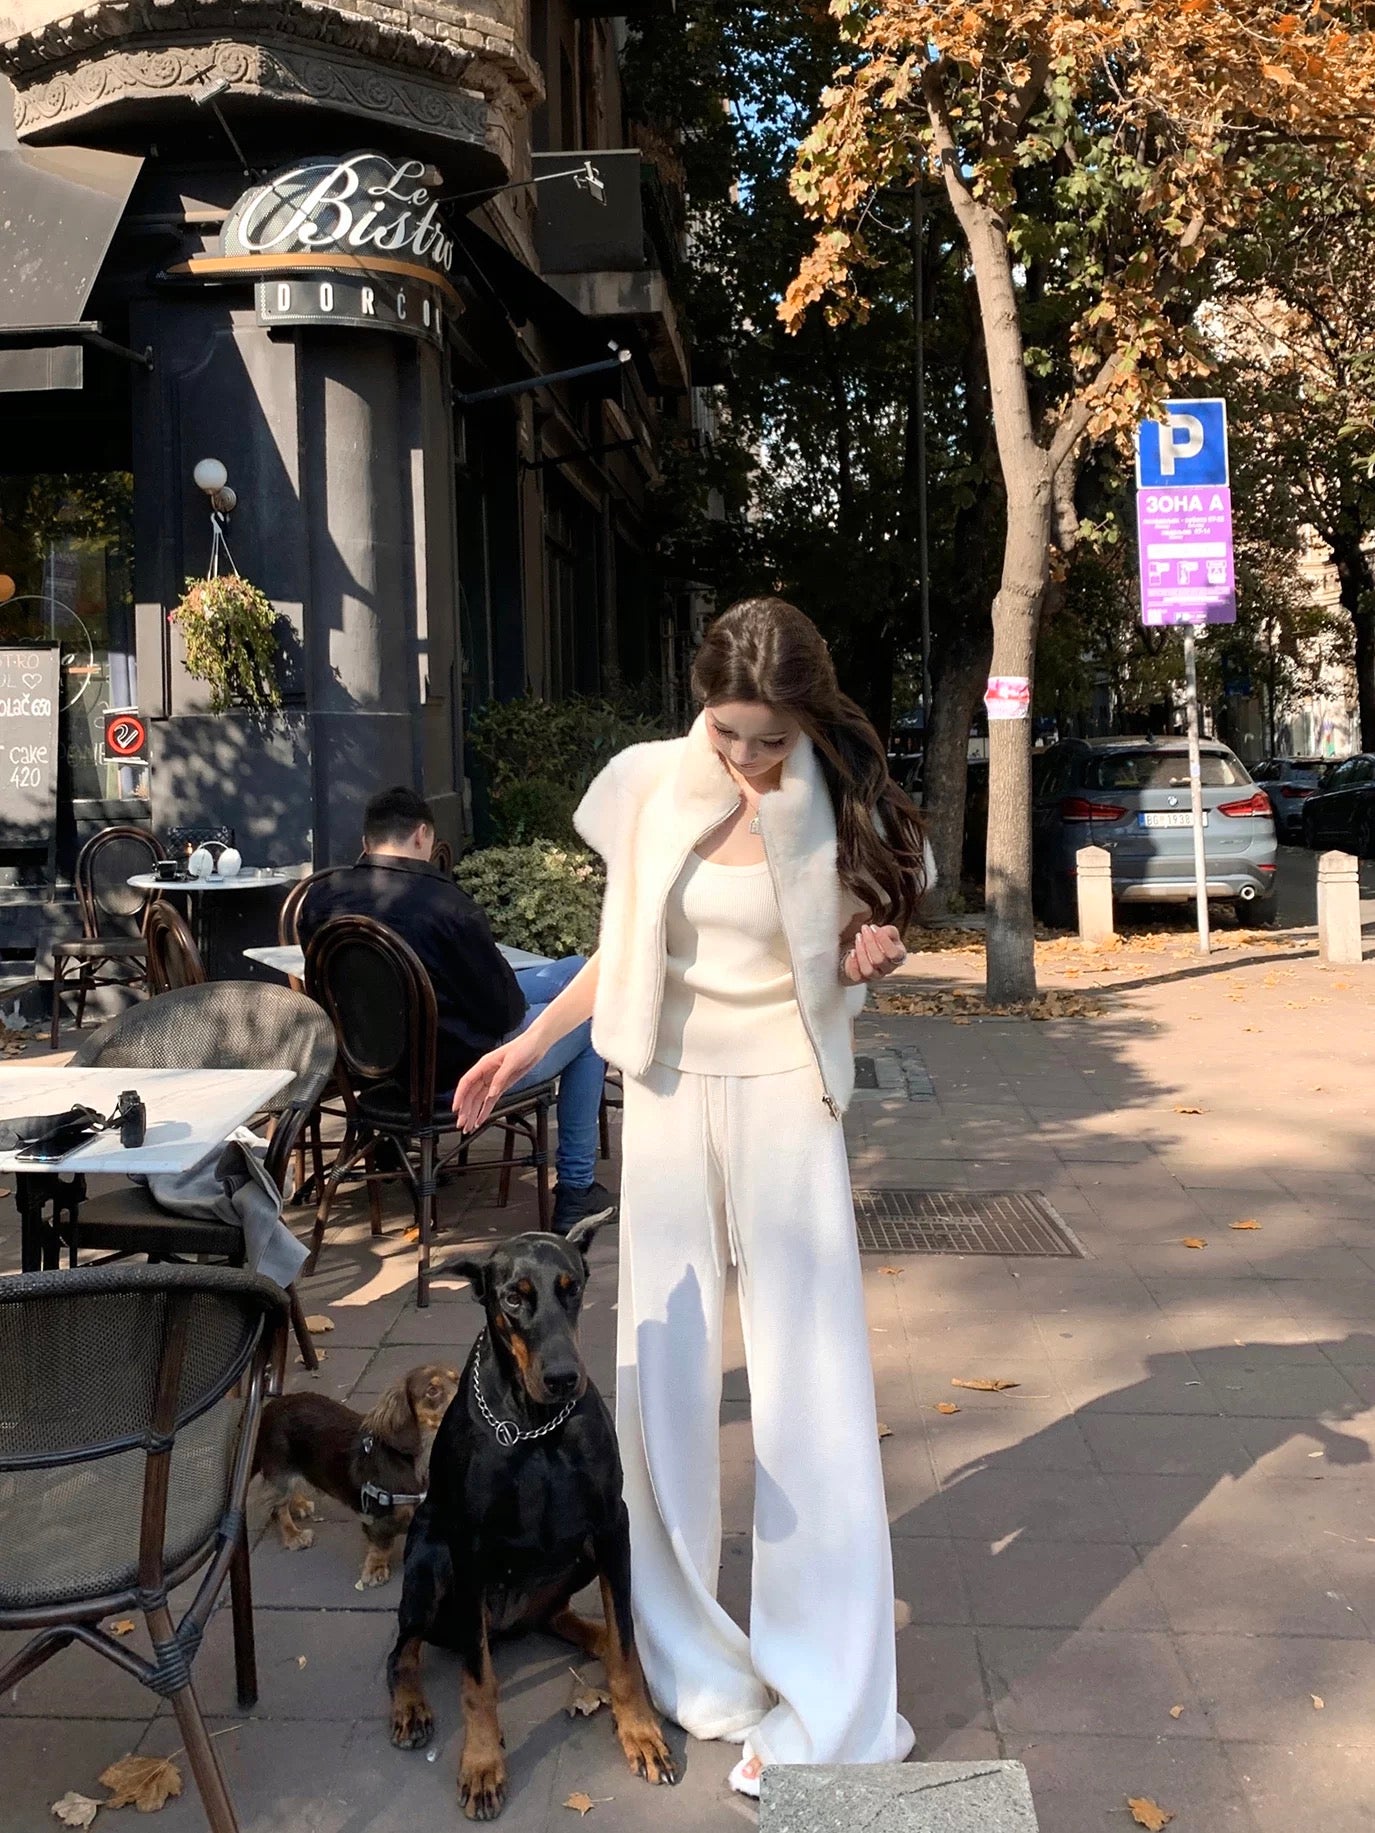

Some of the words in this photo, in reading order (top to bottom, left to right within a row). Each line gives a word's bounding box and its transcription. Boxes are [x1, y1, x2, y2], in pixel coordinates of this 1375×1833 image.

[368, 160, 429, 206] Le
[238, 154, 454, 271] Bistro
[1159, 414, 1204, 476] P
[1146, 495, 1203, 513] ЗОНА
[1209, 494, 1224, 511] А
[10, 745, 48, 764] cake
[10, 766, 41, 788] 420
[1146, 815, 1158, 825] BG
